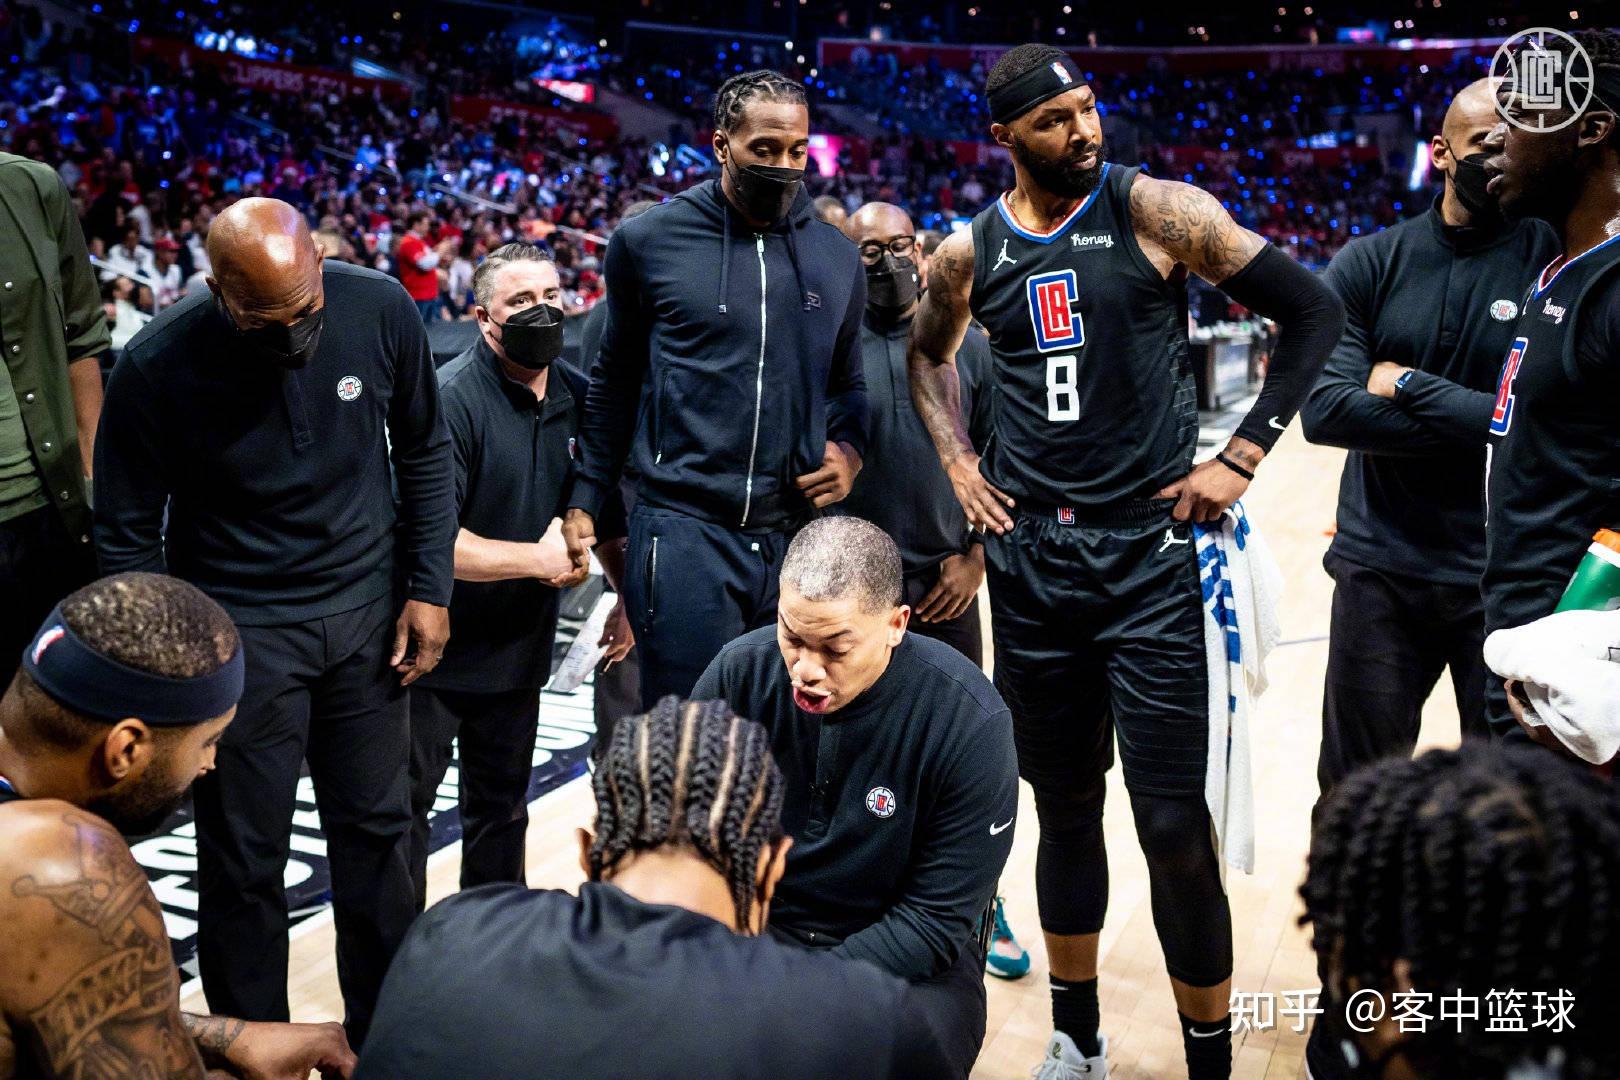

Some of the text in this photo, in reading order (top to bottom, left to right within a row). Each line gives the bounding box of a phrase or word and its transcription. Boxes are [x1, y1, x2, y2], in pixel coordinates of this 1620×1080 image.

[1071, 233, 1114, 248] honey
[1542, 297, 1567, 325] honey
[1046, 355, 1080, 421] 8
